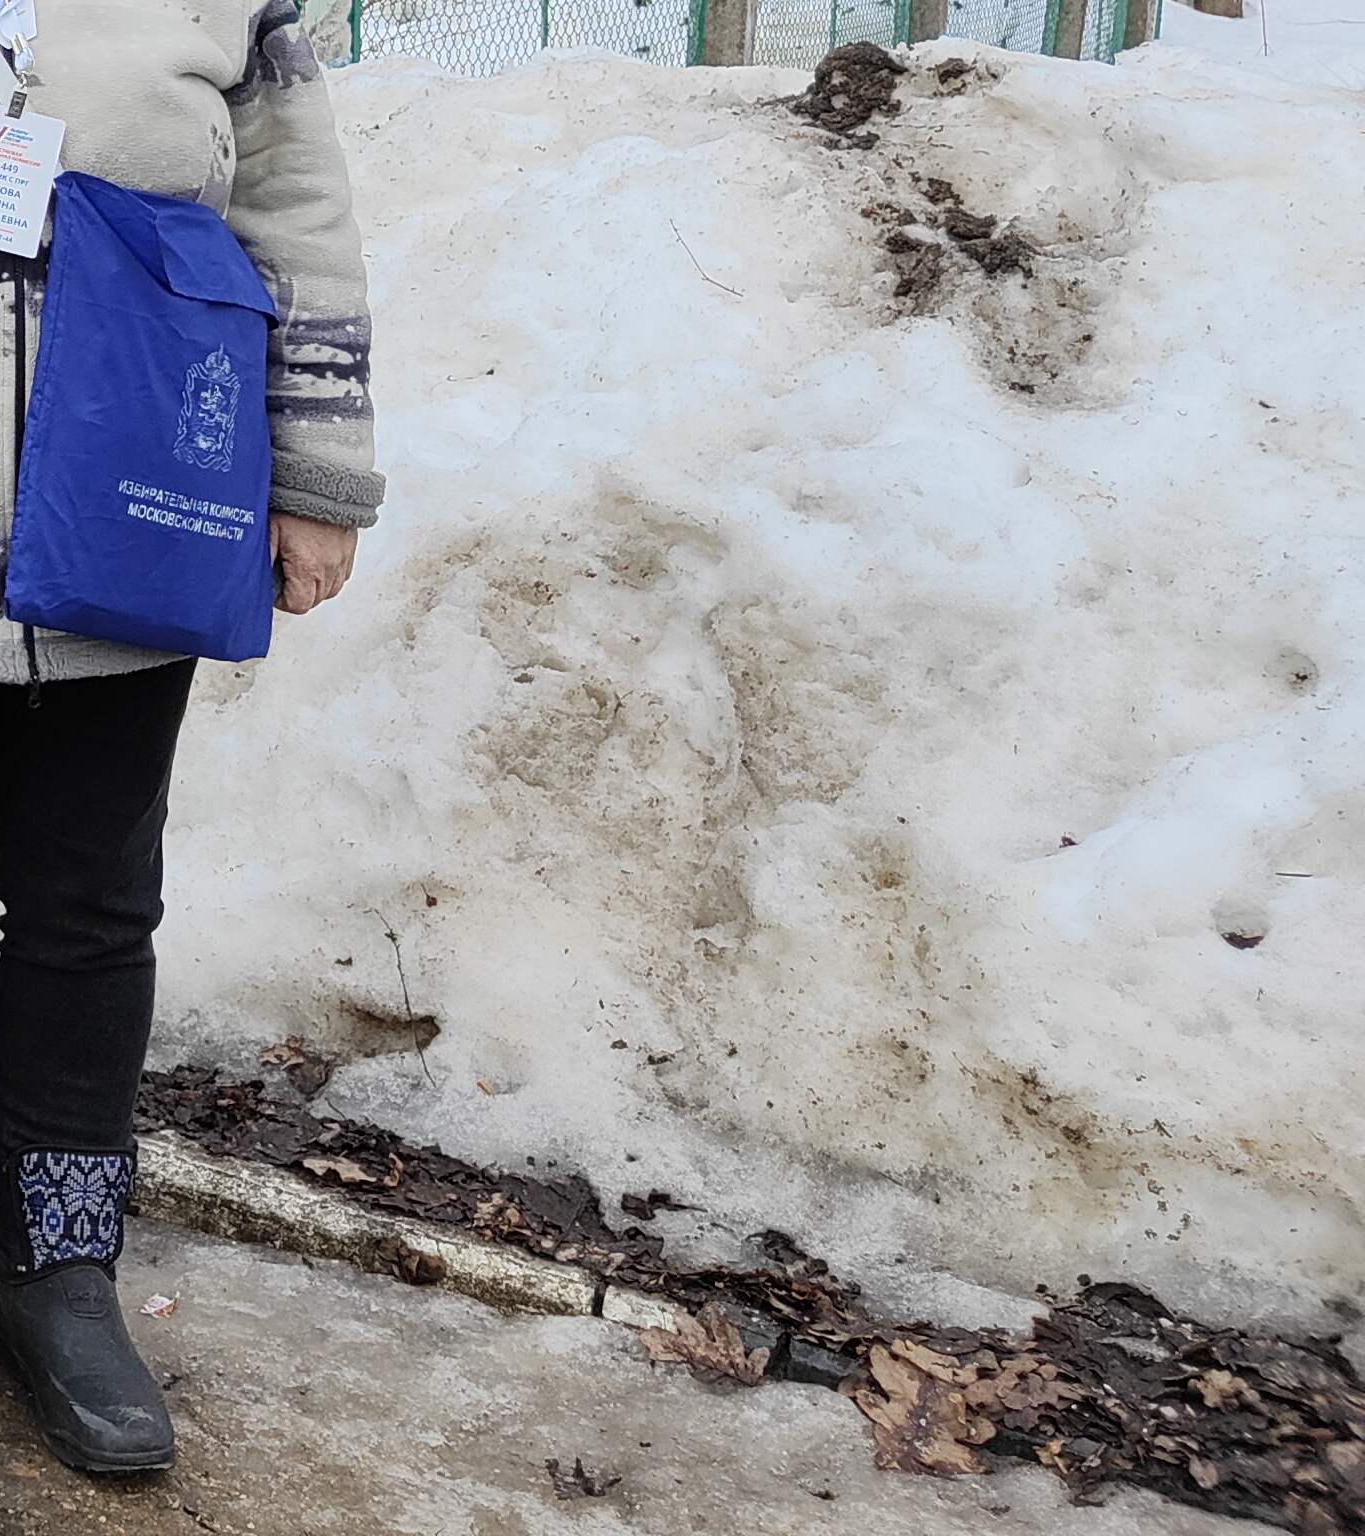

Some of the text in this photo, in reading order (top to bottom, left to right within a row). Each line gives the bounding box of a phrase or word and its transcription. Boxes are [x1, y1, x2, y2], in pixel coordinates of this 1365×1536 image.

[0, 163, 19, 174] 449
[118, 479, 255, 525] ИЗБИРАТЕЛЬНАЯ КОМИССИЯ
[127, 502, 244, 542] МОСКОВСКОЙ ОБЛАСТИ
